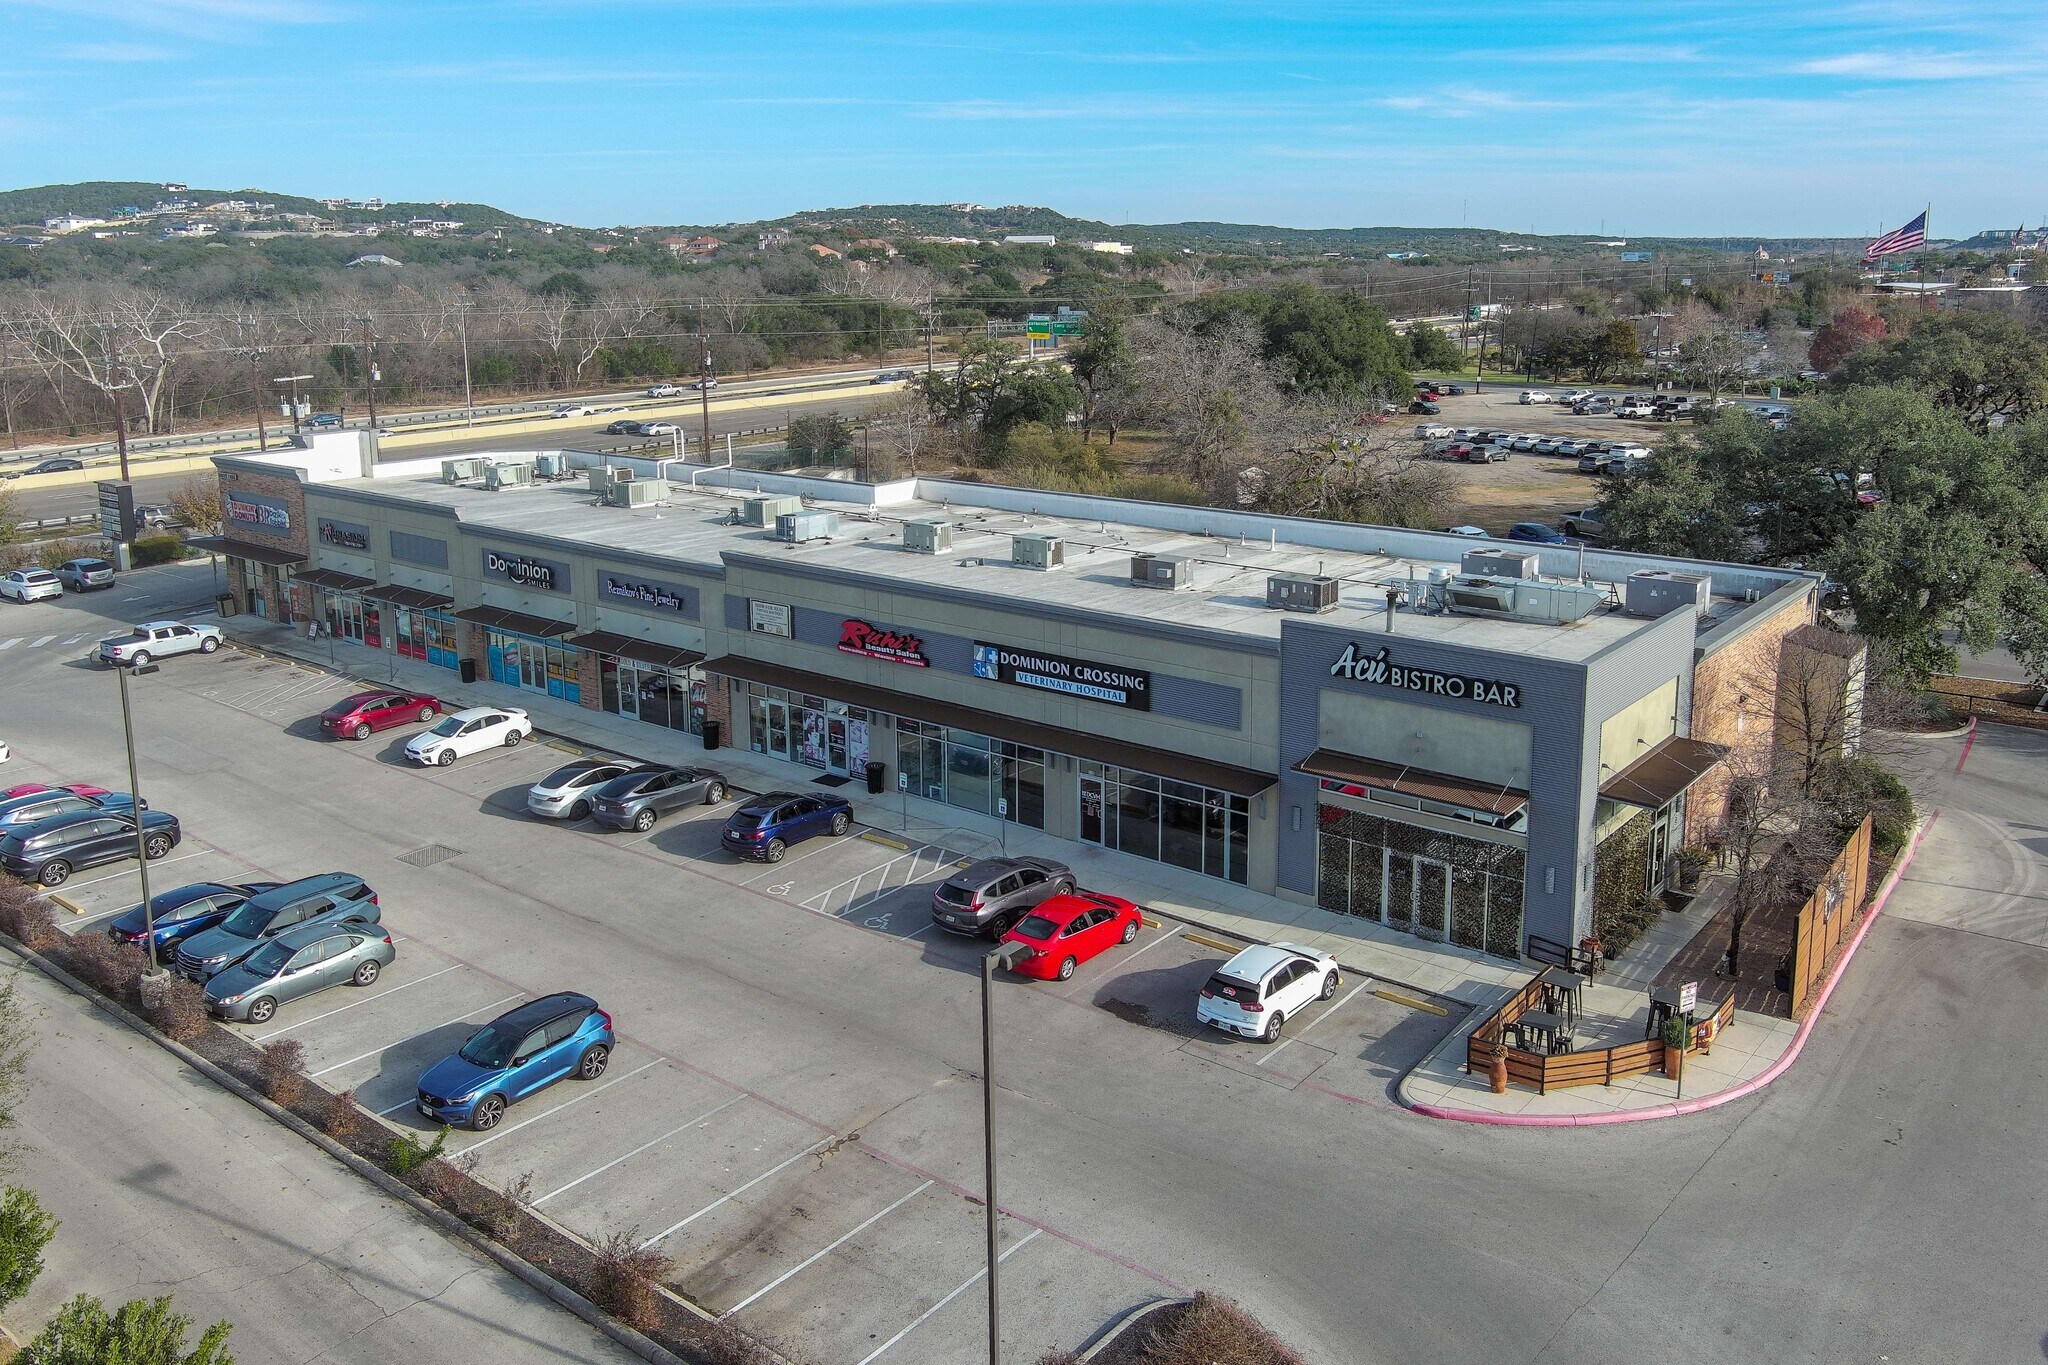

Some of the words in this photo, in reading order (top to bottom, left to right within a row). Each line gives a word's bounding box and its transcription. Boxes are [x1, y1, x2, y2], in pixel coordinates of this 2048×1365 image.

[234, 510, 257, 523] DONUTS
[488, 554, 550, 580] Dominion
[527, 579, 550, 589] SMILES
[607, 580, 640, 599] Reznikov's
[639, 586, 654, 602] Fine
[654, 589, 680, 610] Jewelry
[840, 620, 919, 653] Rishi's
[838, 645, 868, 656] Threading
[874, 652, 896, 662] Waxing
[865, 643, 895, 655] Beauty
[896, 649, 921, 660] Salon
[1000, 651, 1070, 677] DOMINION
[1074, 666, 1145, 691] CROSSING
[1330, 644, 1389, 684] Acú
[1391, 667, 1465, 698] BISTRO
[1473, 681, 1517, 708] BAR
[1018, 672, 1073, 692] VETERINARY
[1077, 685, 1124, 702] HOSPITAL
